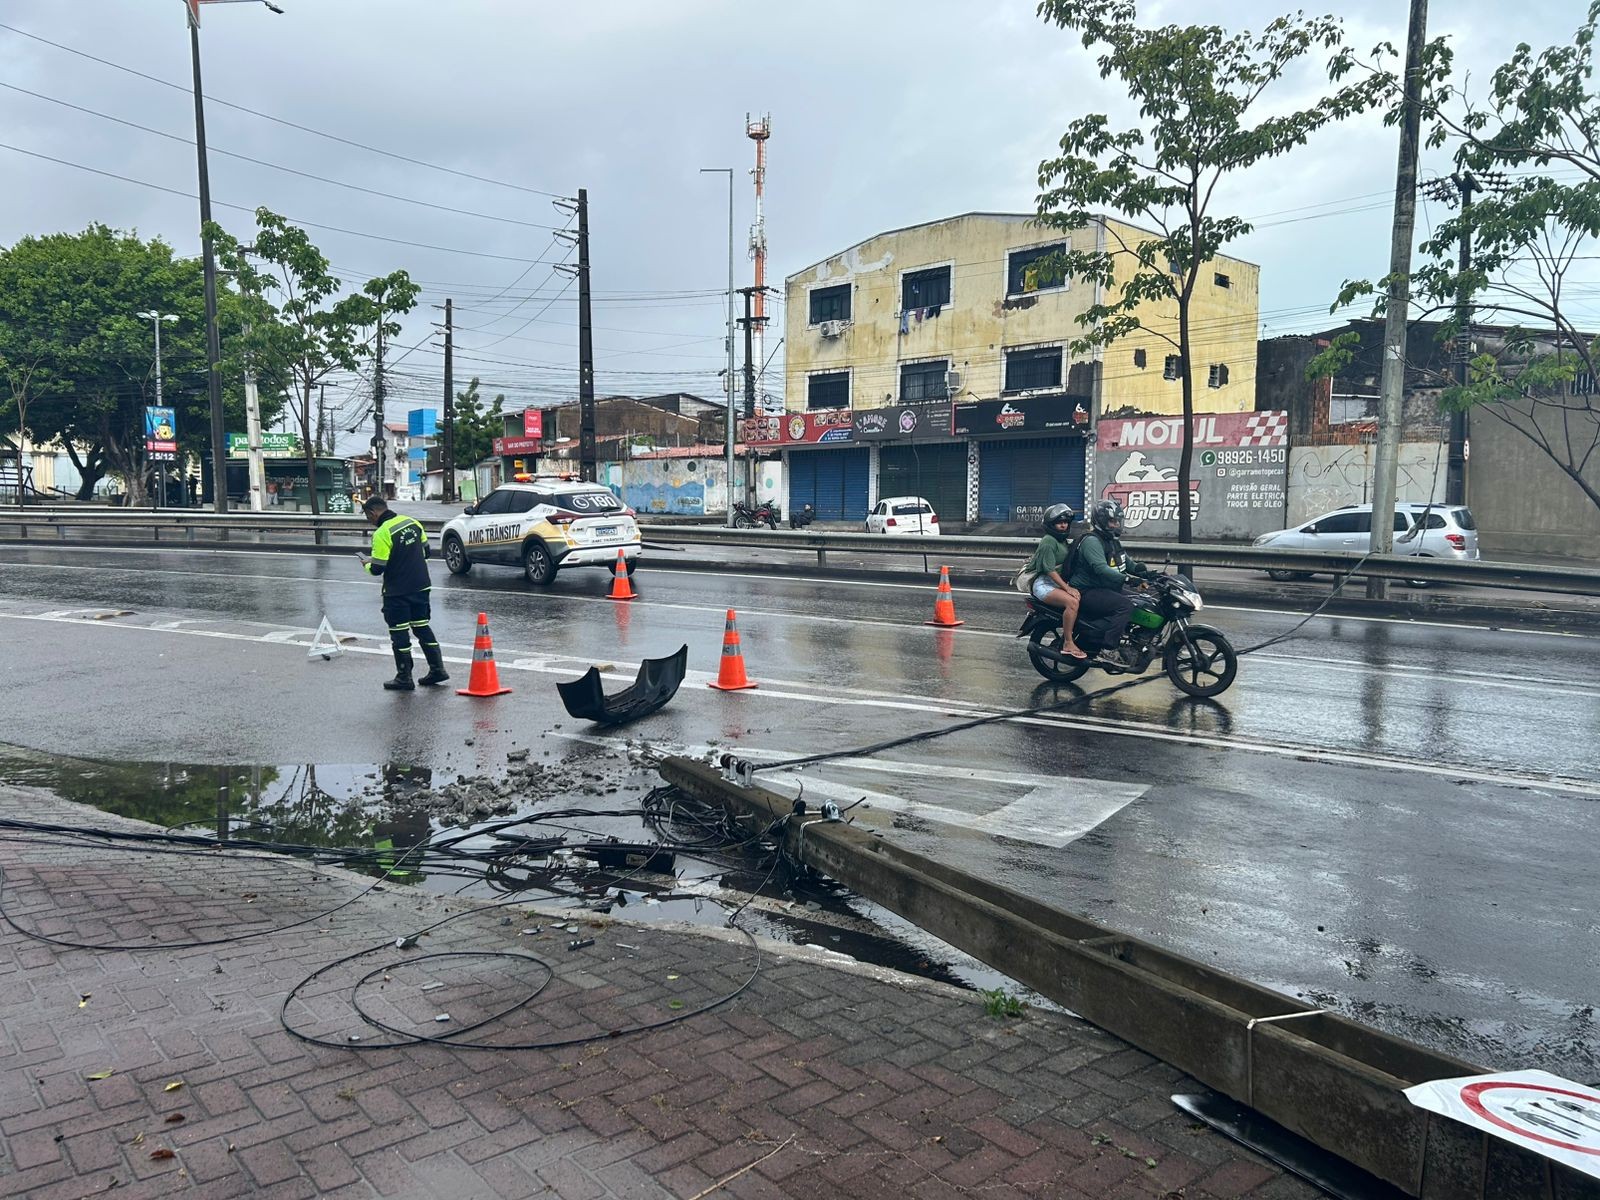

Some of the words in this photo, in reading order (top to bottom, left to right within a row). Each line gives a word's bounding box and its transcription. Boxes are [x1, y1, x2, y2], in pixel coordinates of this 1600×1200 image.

[1119, 417, 1224, 447] MOTUL
[234, 434, 290, 447] patodos
[1217, 448, 1286, 465] 98926-1450
[1230, 482, 1258, 492] REVISÃO
[1259, 483, 1281, 491] GERAL
[587, 495, 618, 507] 190
[1226, 492, 1248, 500] PARTE
[1016, 505, 1043, 514] GARRA
[1226, 500, 1248, 508] TROCA
[1252, 500, 1262, 508] DE
[468, 529, 484, 544] AMC
[485, 523, 521, 542] TRÂNSITO
